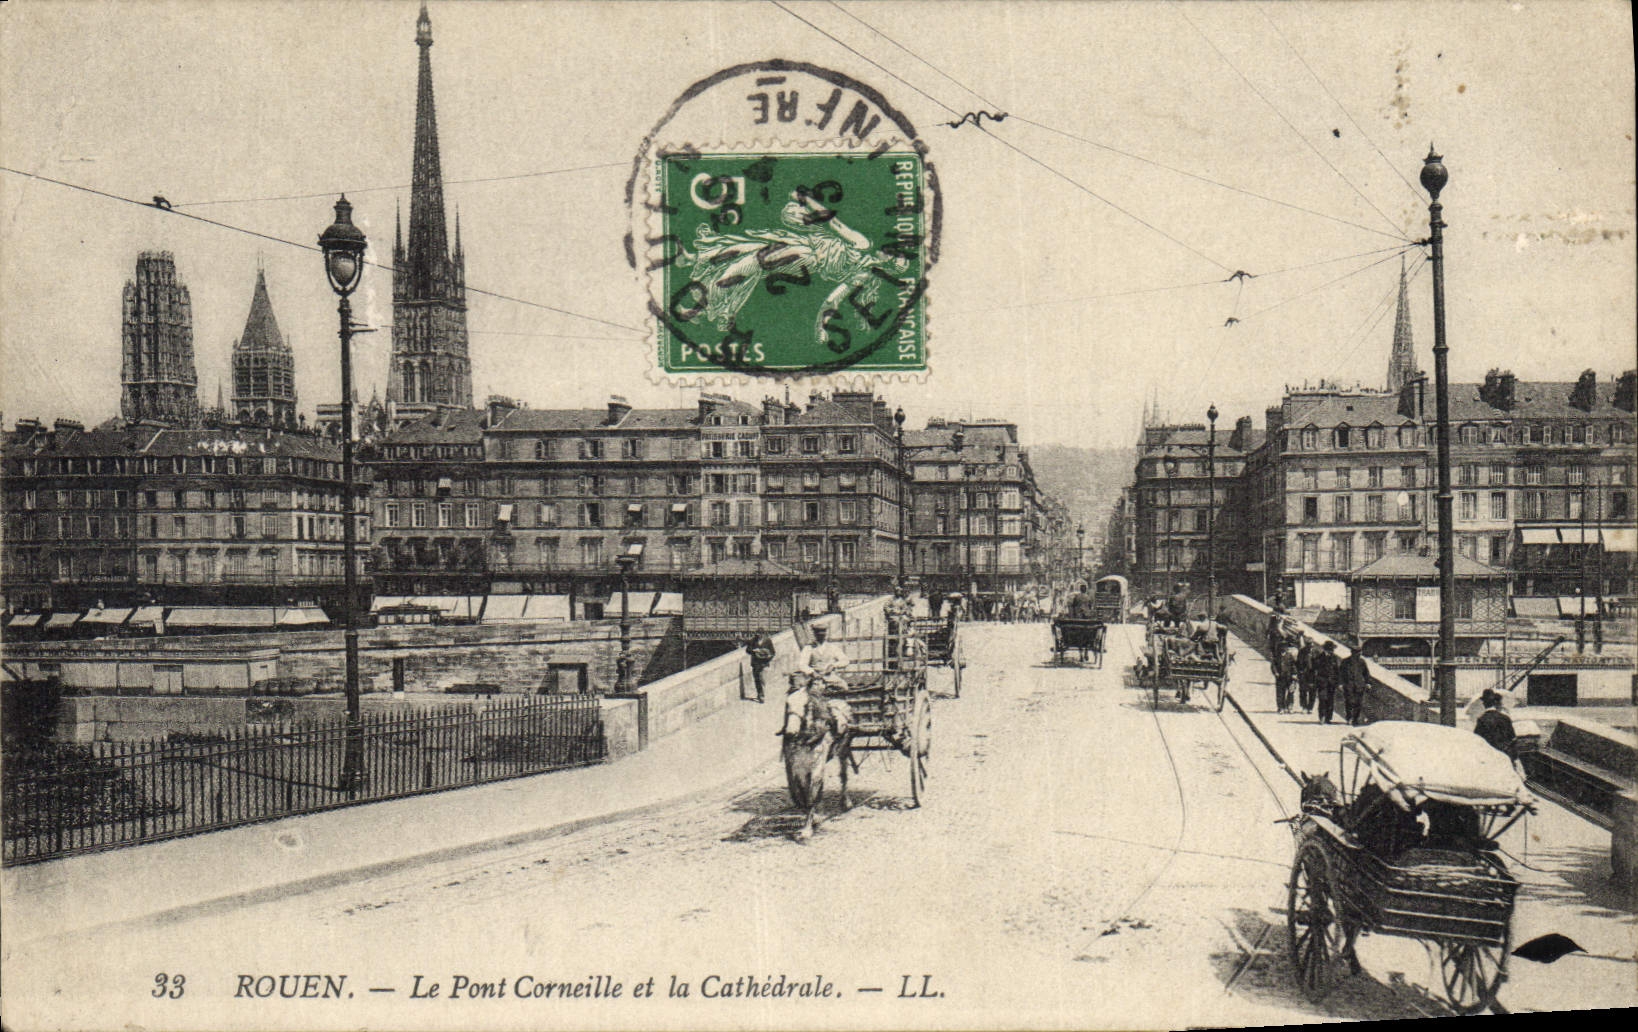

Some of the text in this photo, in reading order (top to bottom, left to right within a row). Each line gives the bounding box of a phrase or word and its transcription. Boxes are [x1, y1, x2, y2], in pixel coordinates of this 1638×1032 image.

[690, 172, 746, 210] 5
[895, 160, 915, 250] REPUIQUE
[680, 342, 766, 363] POSTES
